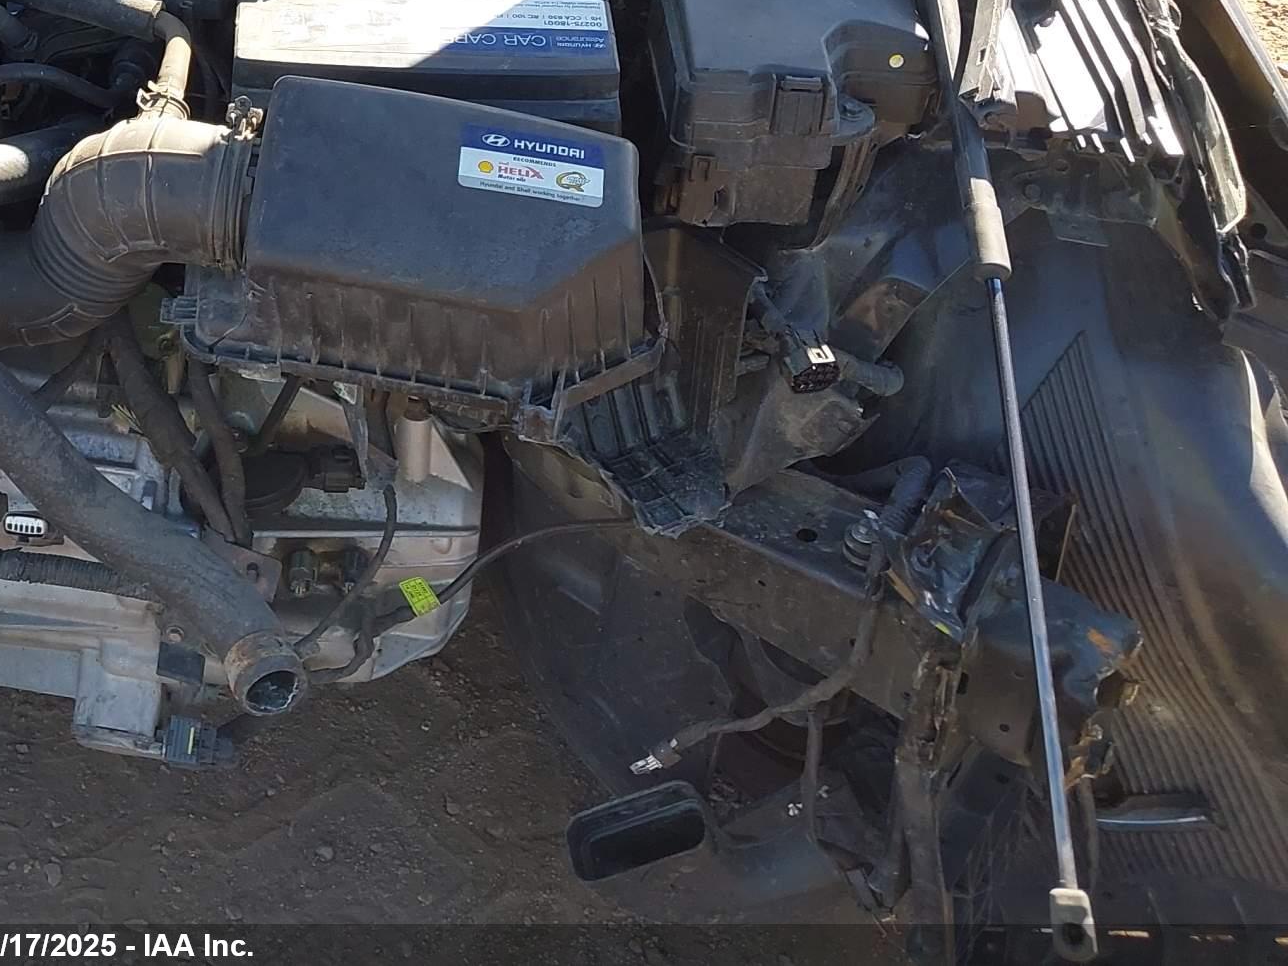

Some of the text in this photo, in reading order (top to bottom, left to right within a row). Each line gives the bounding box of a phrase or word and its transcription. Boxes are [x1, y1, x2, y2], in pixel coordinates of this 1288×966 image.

[503, 34, 546, 47] CAR
[555, 35, 605, 43] Assurance
[514, 138, 585, 159] HYUNDAI
[512, 156, 557, 168] RECOMMENDS
[497, 165, 545, 180] HELIX
